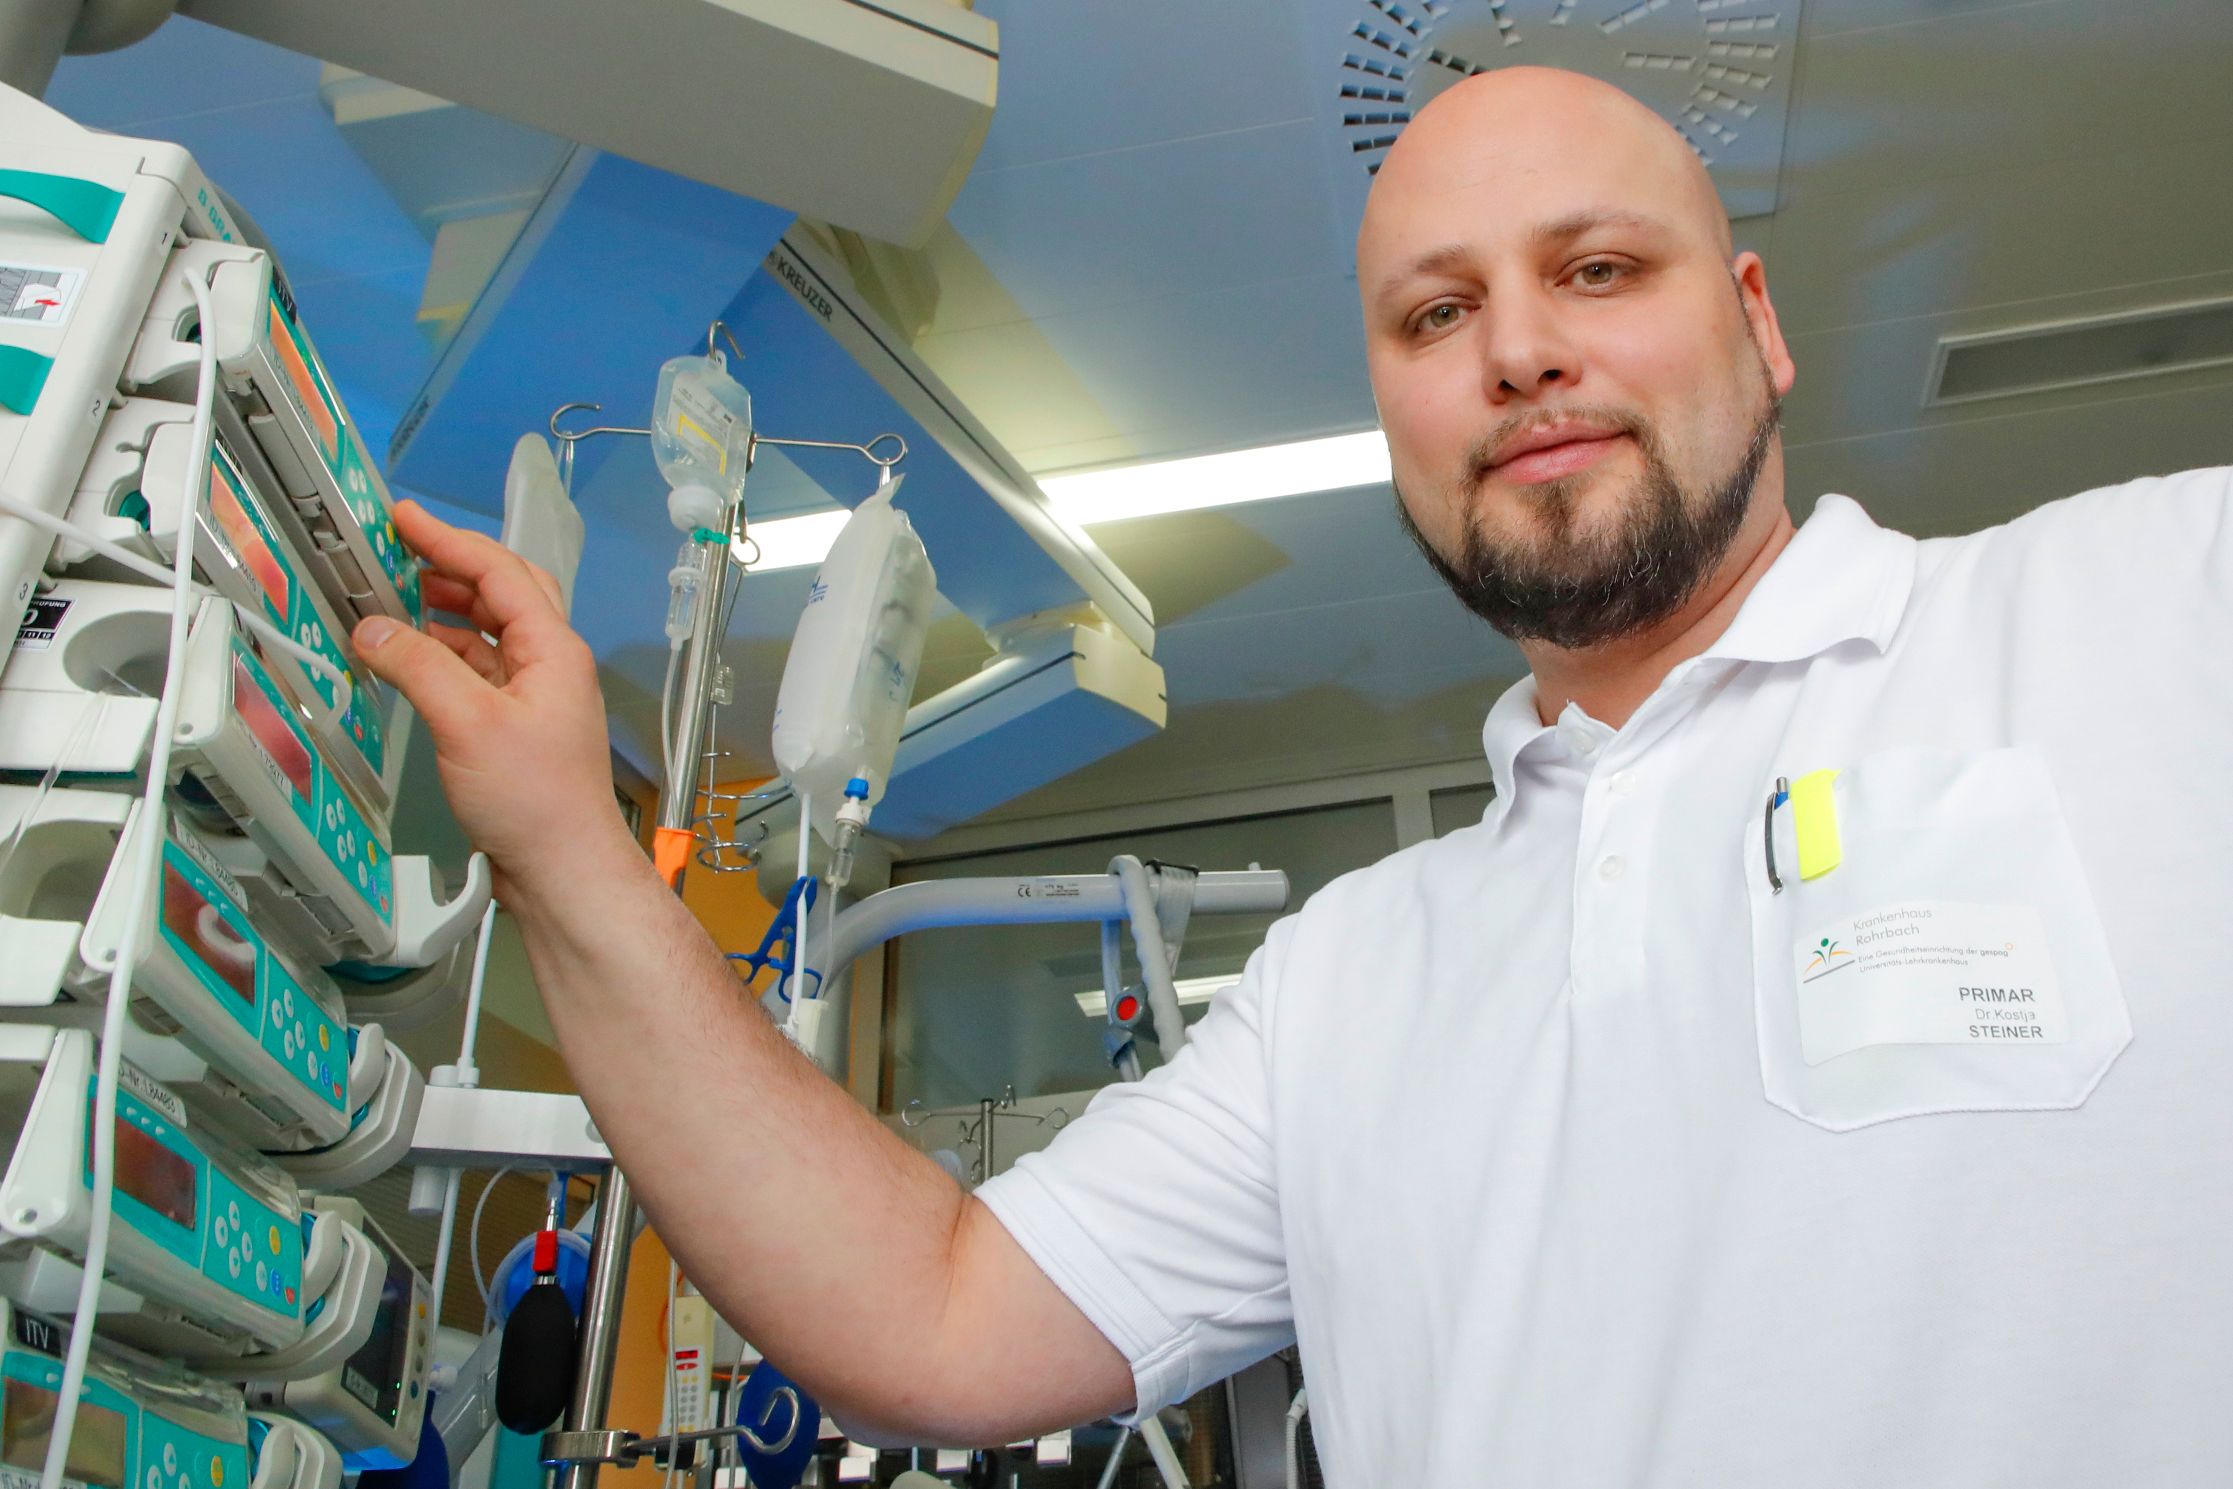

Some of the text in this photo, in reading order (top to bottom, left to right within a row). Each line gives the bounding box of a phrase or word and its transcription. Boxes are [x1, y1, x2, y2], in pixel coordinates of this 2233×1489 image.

[777, 256, 833, 322] KREUZER
[92, 399, 101, 417] 2
[19, 583, 29, 601] 3
[1853, 907, 1933, 931] Krankenhaus
[1856, 923, 1920, 947] Rohrbach
[1858, 953, 1873, 963] Eine
[1875, 946, 1963, 958] Gesundheitseinrichtung
[1966, 947, 1977, 955] der
[1958, 986, 2036, 1002] PRIMAR
[1969, 1024, 2043, 1039] STEINER
[25, 1317, 49, 1350] ITV
